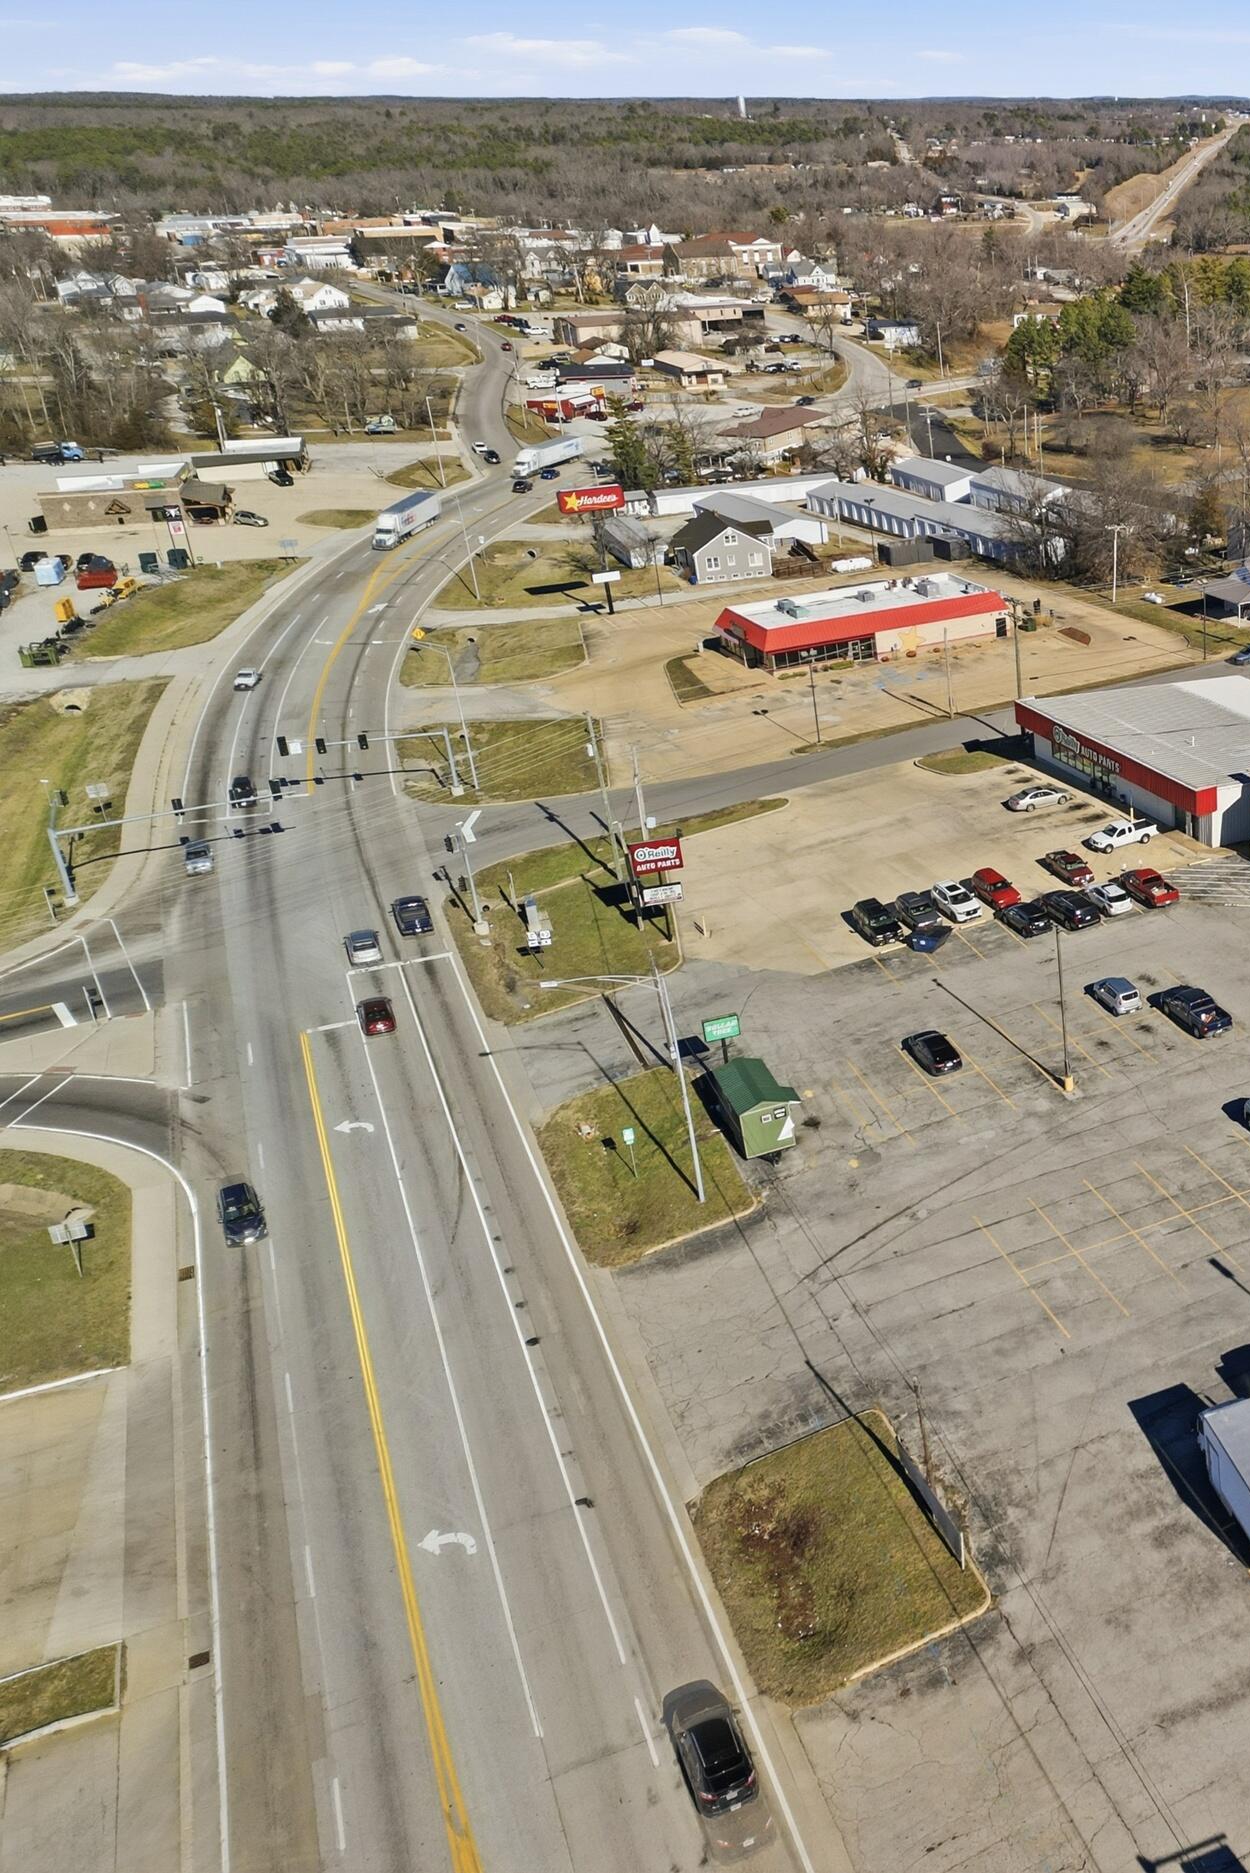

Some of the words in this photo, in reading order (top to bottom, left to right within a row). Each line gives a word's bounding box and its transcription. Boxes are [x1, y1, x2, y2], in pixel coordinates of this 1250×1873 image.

[1081, 745, 1097, 762] AUTO
[1099, 754, 1119, 774] PARTS
[635, 846, 677, 861] O'Reilly
[637, 862, 656, 872] AUTO
[657, 858, 680, 868] PARTS
